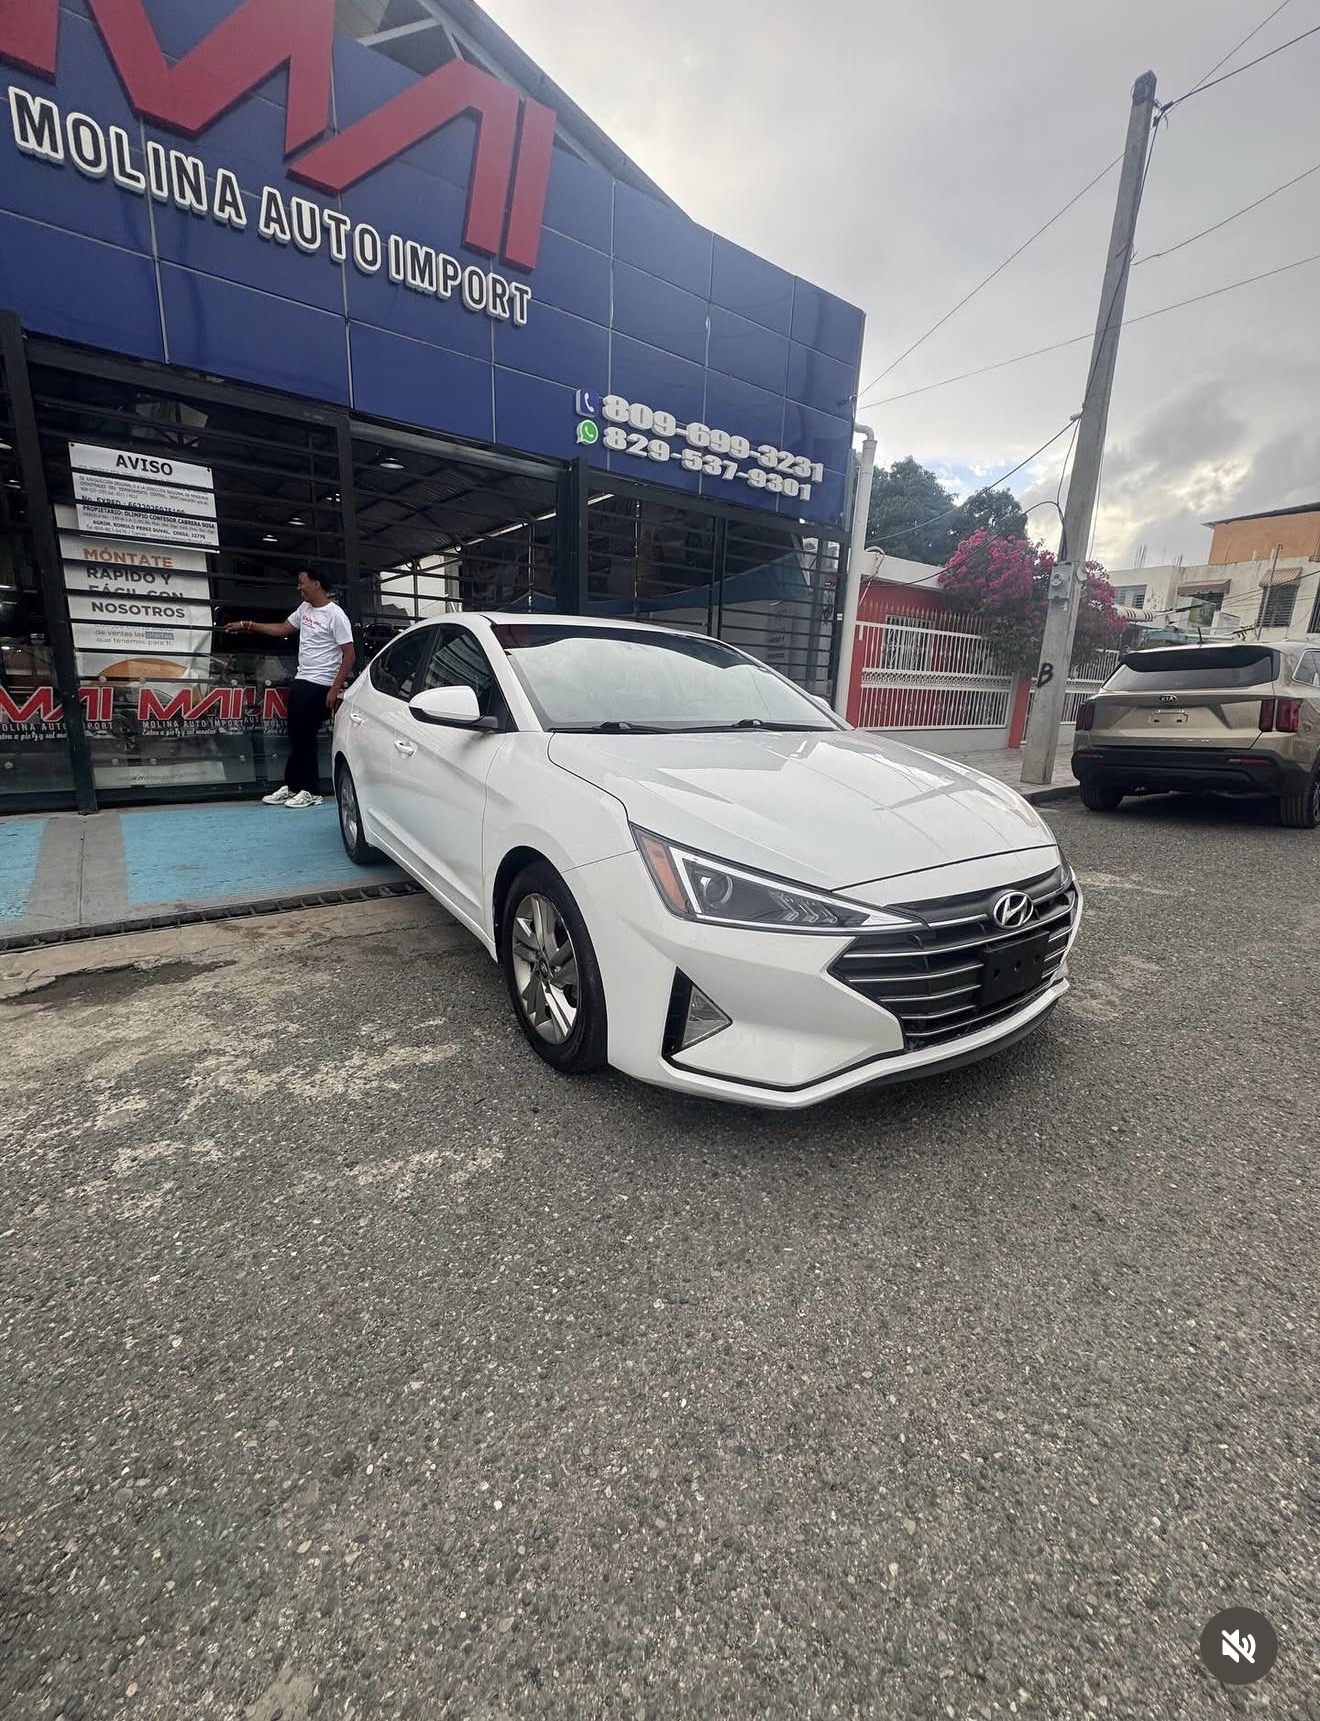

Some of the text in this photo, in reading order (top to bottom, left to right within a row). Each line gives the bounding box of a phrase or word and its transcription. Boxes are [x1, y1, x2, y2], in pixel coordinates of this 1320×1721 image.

[8, 87, 532, 326] MOLINA AUTO IMPORT
[602, 394, 824, 483] 809-699-3231
[115, 454, 173, 476] AVISO
[603, 426, 812, 501] 829-537-9301
[83, 547, 174, 568] MÓNTATE
[161, 573, 172, 585] Y
[91, 601, 186, 618] NOSOTROS
[1037, 662, 1054, 689] B
[137, 687, 244, 721] MAI
[2, 722, 36, 731] OLINA
[142, 720, 178, 729] MOLINA
[183, 720, 207, 728] AUTO
